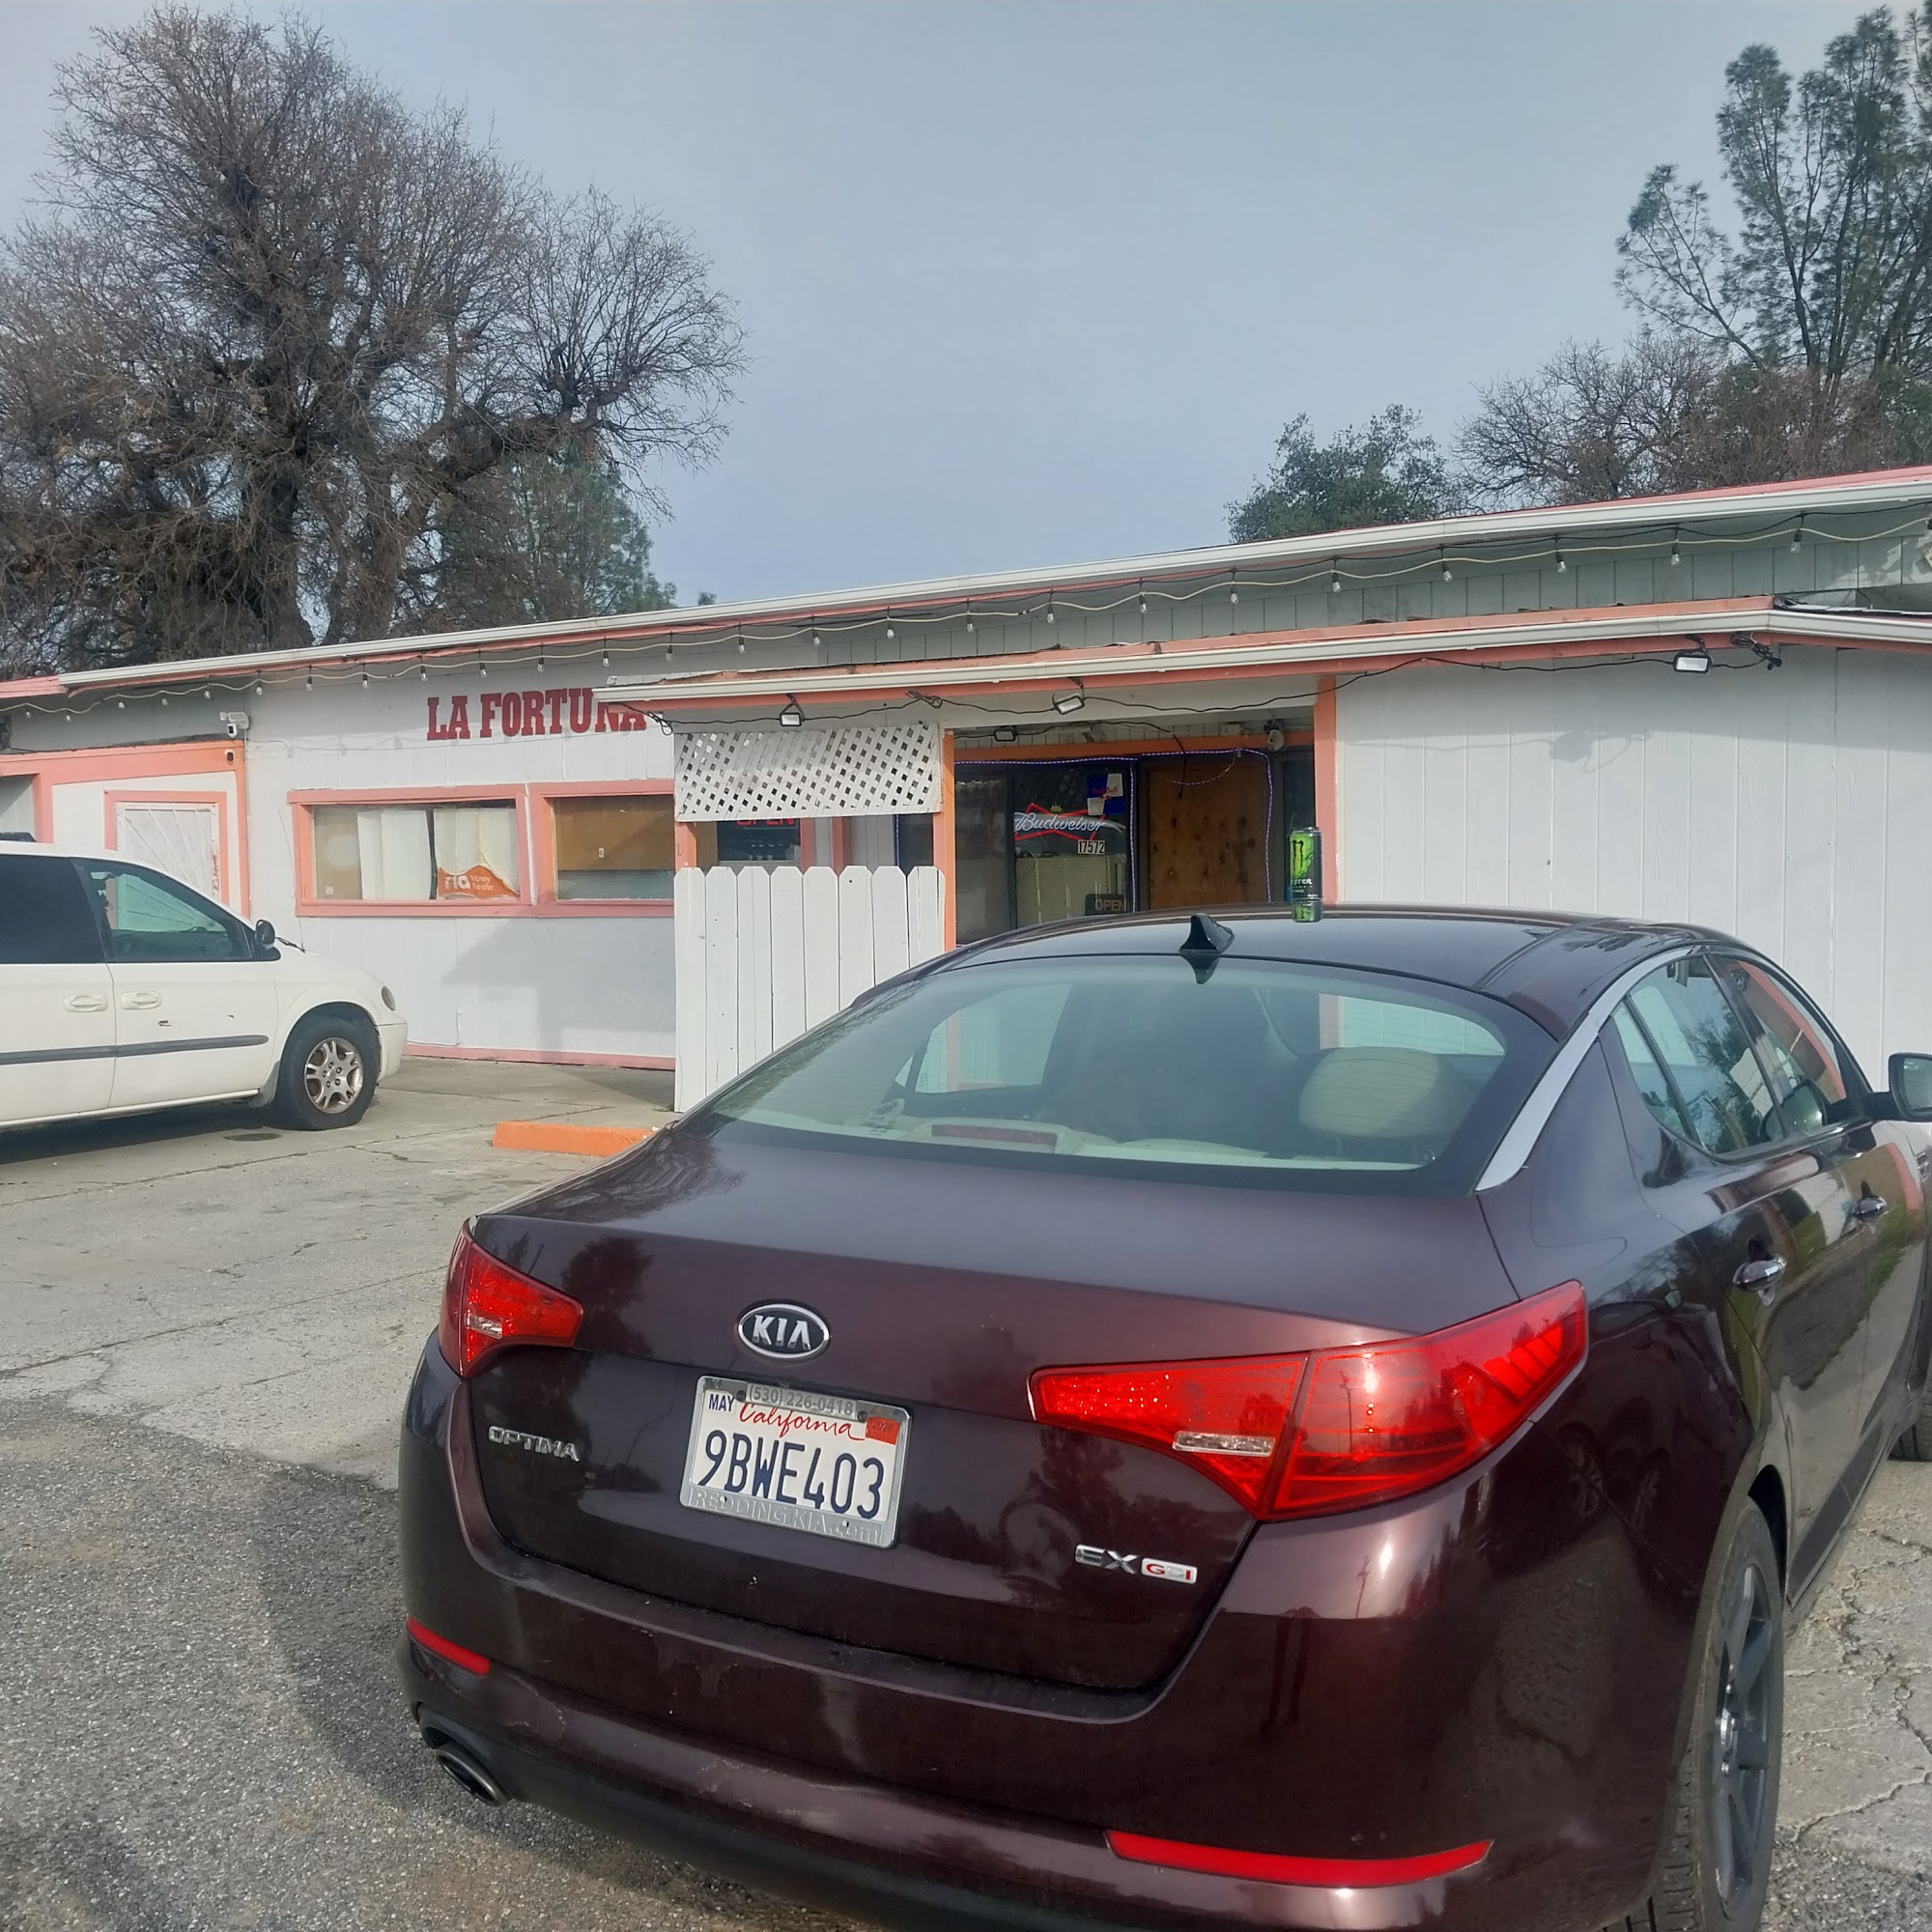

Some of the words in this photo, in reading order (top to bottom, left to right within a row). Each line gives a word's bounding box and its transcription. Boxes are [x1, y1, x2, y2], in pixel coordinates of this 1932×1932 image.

[426, 695, 471, 741] LA
[1014, 811, 1107, 832] Budweiser
[1078, 840, 1105, 854] 17572
[1094, 898, 1127, 912] OPEN
[752, 1314, 812, 1350] KIA
[708, 1393, 735, 1412] MAY
[750, 1385, 783, 1406] (530)
[786, 1391, 854, 1415] 226-0418
[739, 1402, 866, 1438] California
[488, 1425, 580, 1463] OPTIMA
[698, 1430, 885, 1520] 9BWE403
[1074, 1544, 1140, 1575] EX
[1144, 1561, 1193, 1581] GDI
